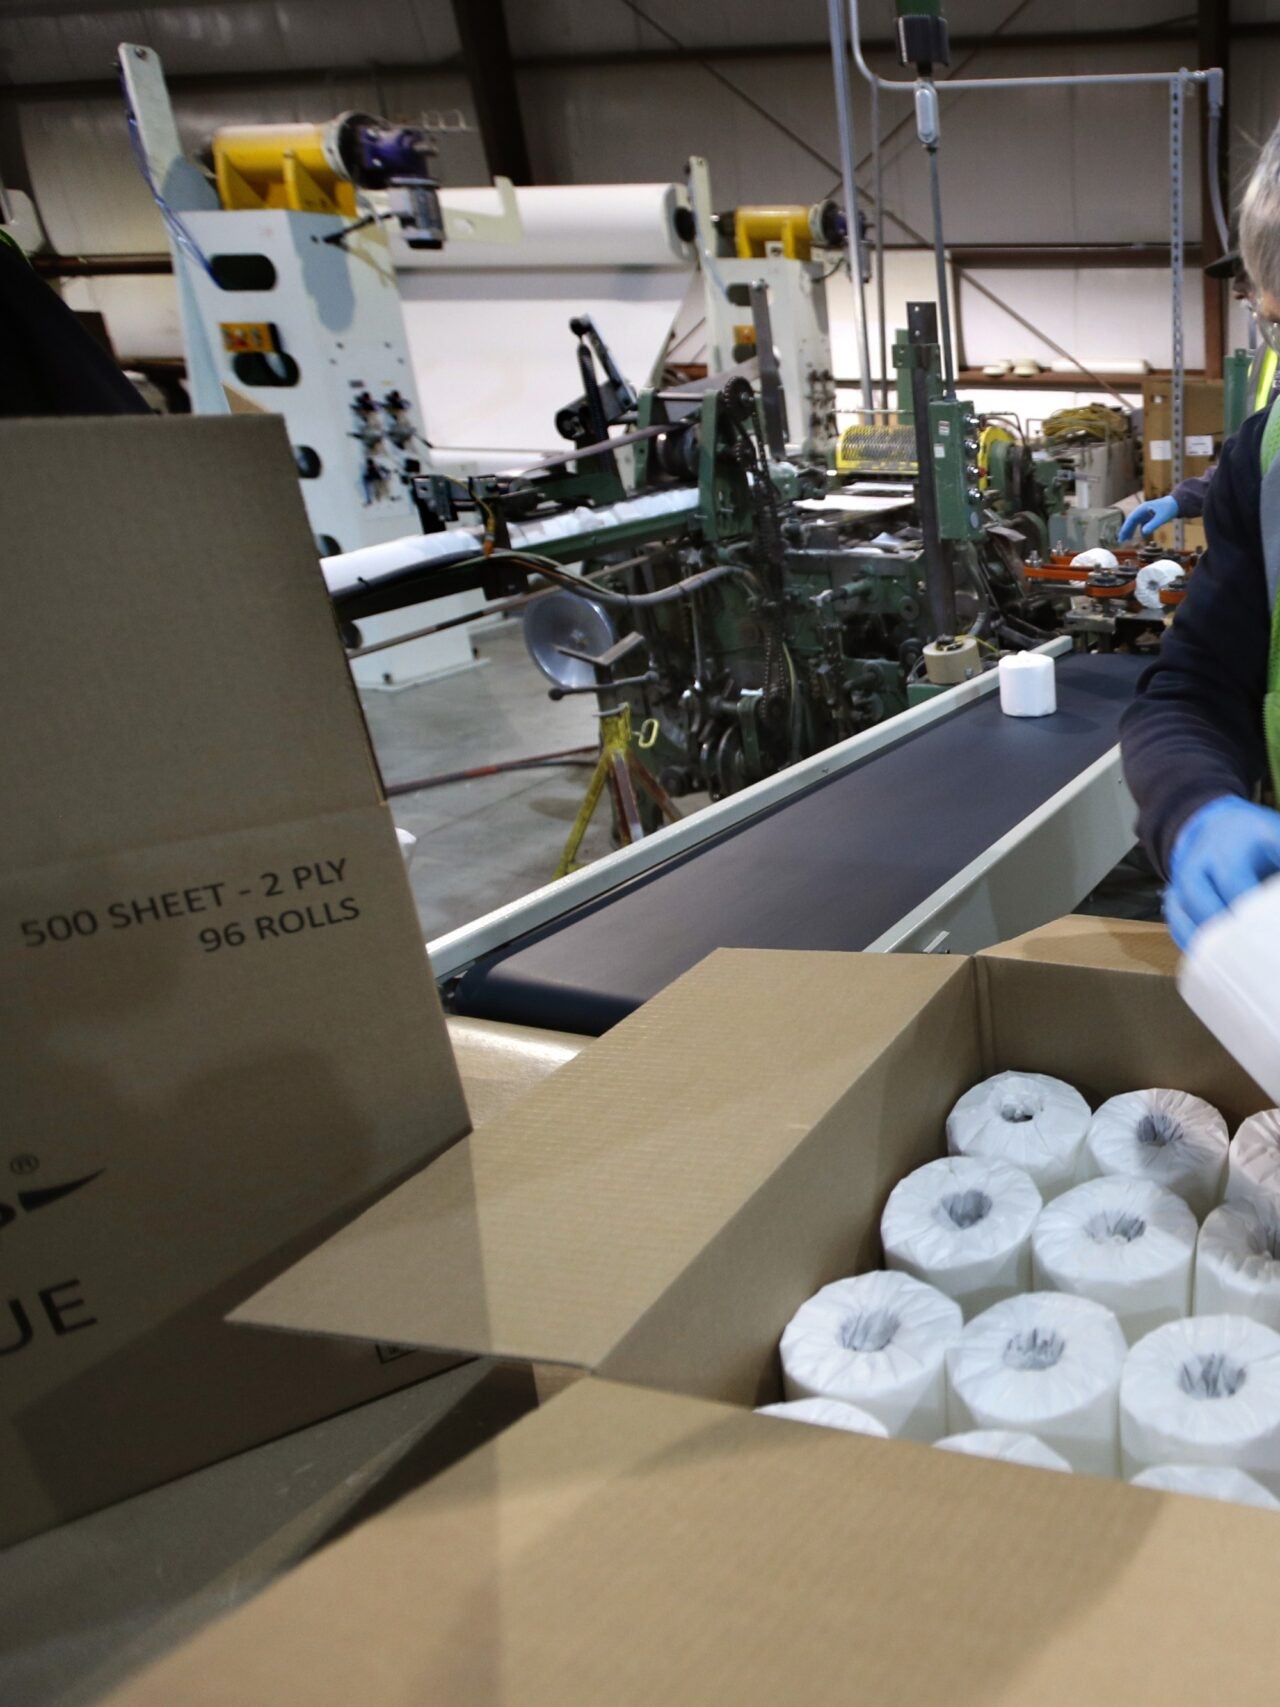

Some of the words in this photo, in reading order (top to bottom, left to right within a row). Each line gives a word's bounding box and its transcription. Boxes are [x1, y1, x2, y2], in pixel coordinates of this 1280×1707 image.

[20, 909, 98, 948] 500
[107, 882, 226, 930] SHEET
[238, 888, 252, 896] -
[260, 872, 284, 898] 2
[292, 857, 347, 890] PLY
[198, 921, 246, 953] 96
[255, 896, 361, 941] ROLLS
